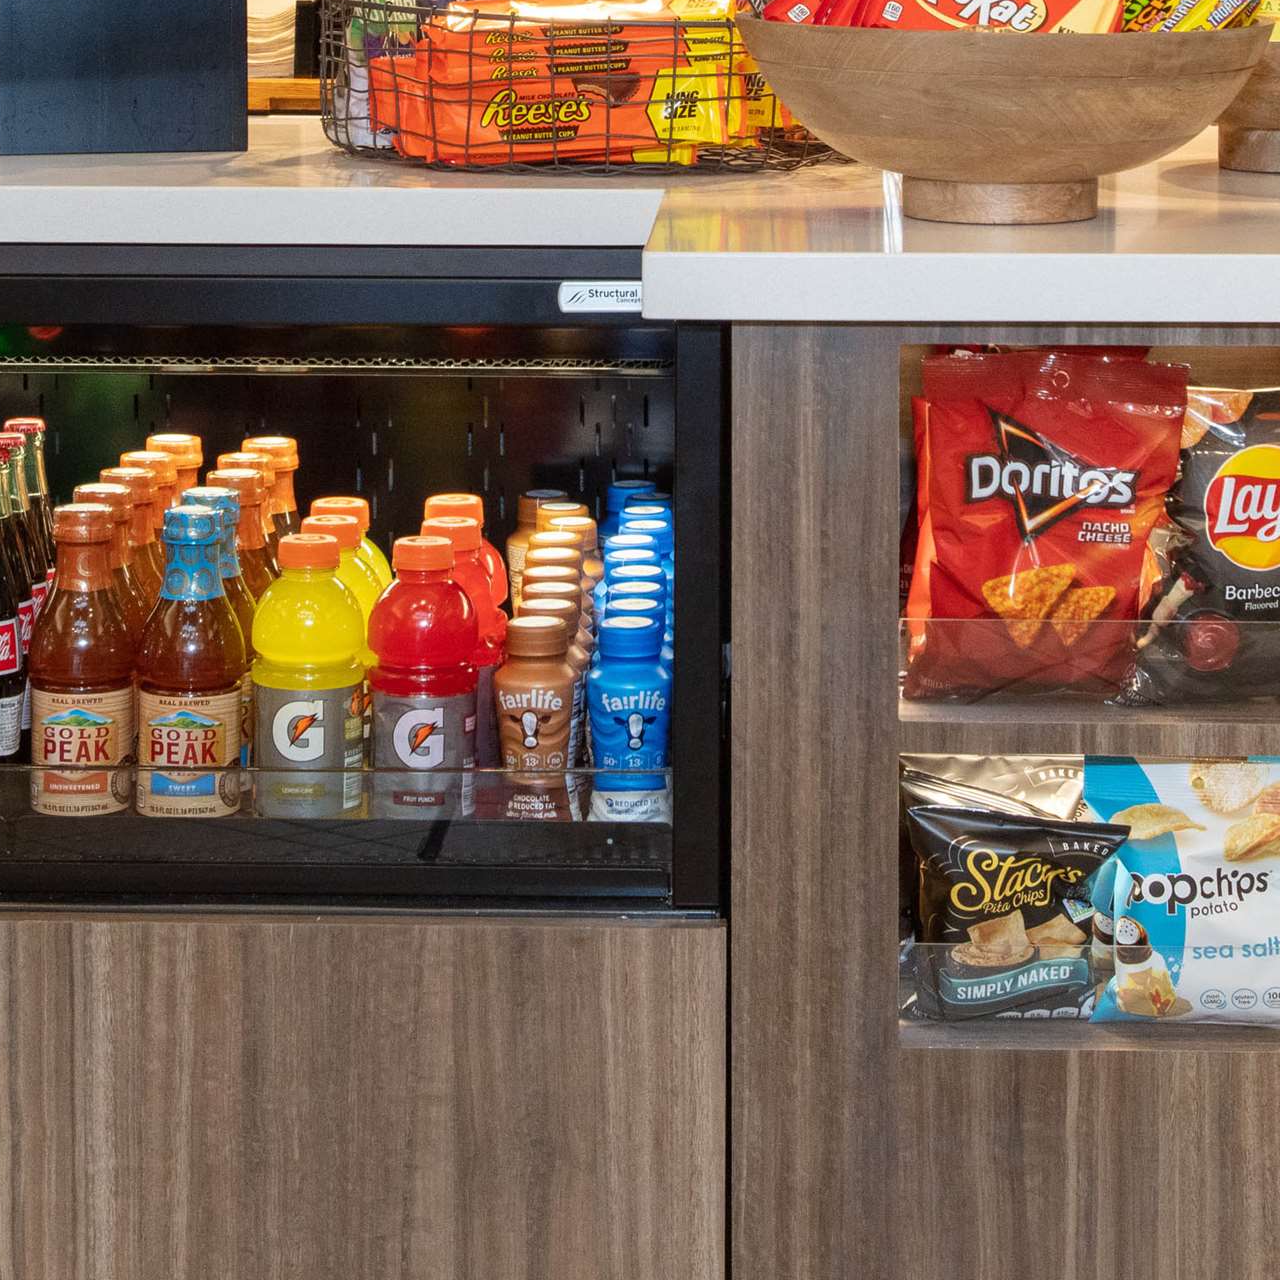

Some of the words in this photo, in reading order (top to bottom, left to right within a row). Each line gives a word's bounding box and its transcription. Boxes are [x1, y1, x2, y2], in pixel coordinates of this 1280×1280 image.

[557, 65, 583, 74] PEANUT
[480, 88, 593, 129] Reese's
[665, 90, 700, 106] KING
[664, 104, 698, 120] SIZE
[588, 288, 638, 298] Structural
[970, 456, 1136, 504] Doritos
[1077, 531, 1131, 545] CHEESE
[1082, 521, 1130, 534] NACHO
[1244, 599, 1279, 611] Flavored
[43, 726, 110, 740] GOLD
[150, 728, 217, 741] GOLD
[272, 700, 327, 762] G
[393, 708, 445, 770] G
[43, 739, 111, 762] PEAK
[150, 740, 218, 765] PEAK
[1062, 841, 1110, 856] BAKED
[950, 848, 1082, 913] Stacy's
[983, 902, 1011, 915] Pita
[1012, 887, 1045, 909] Chips
[1126, 867, 1270, 916] popchips
[1190, 899, 1239, 919] potato
[1192, 942, 1233, 960] sea
[1241, 935, 1280, 958] salt
[957, 977, 1013, 1001] SIMPLY
[1018, 966, 1070, 988] NAKED
